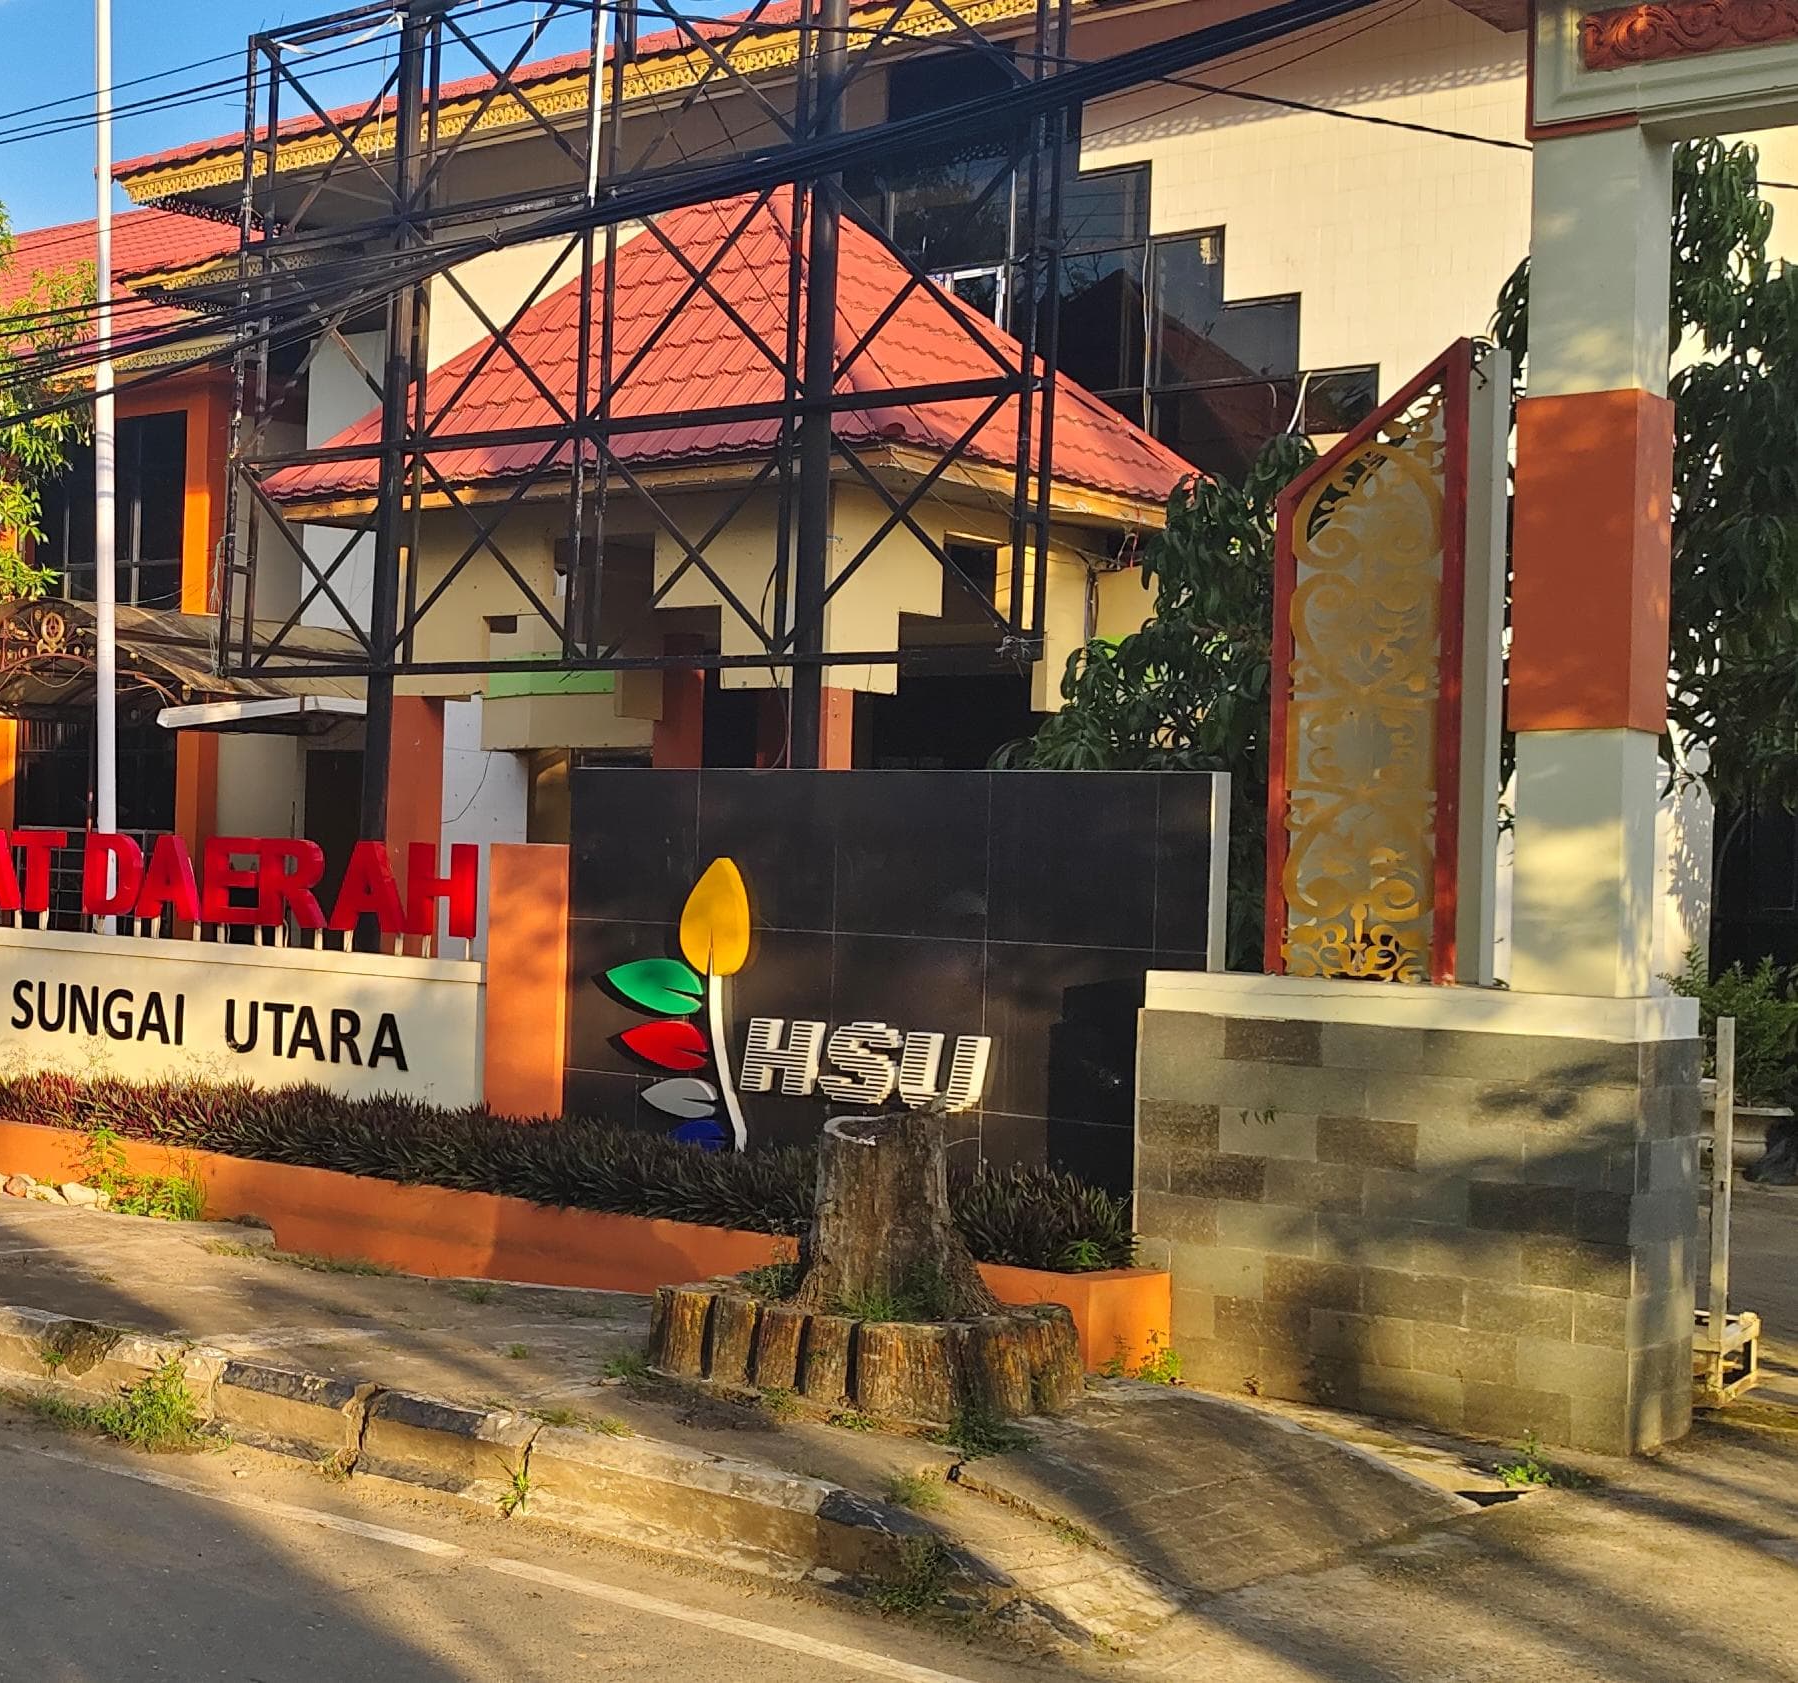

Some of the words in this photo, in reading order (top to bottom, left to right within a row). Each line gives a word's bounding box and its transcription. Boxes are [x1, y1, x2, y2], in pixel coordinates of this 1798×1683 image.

[83, 831, 478, 939] DAERAH
[10, 979, 185, 1046] SUNGAI
[224, 998, 408, 1072] UTARA
[739, 1017, 991, 1112] HSU
